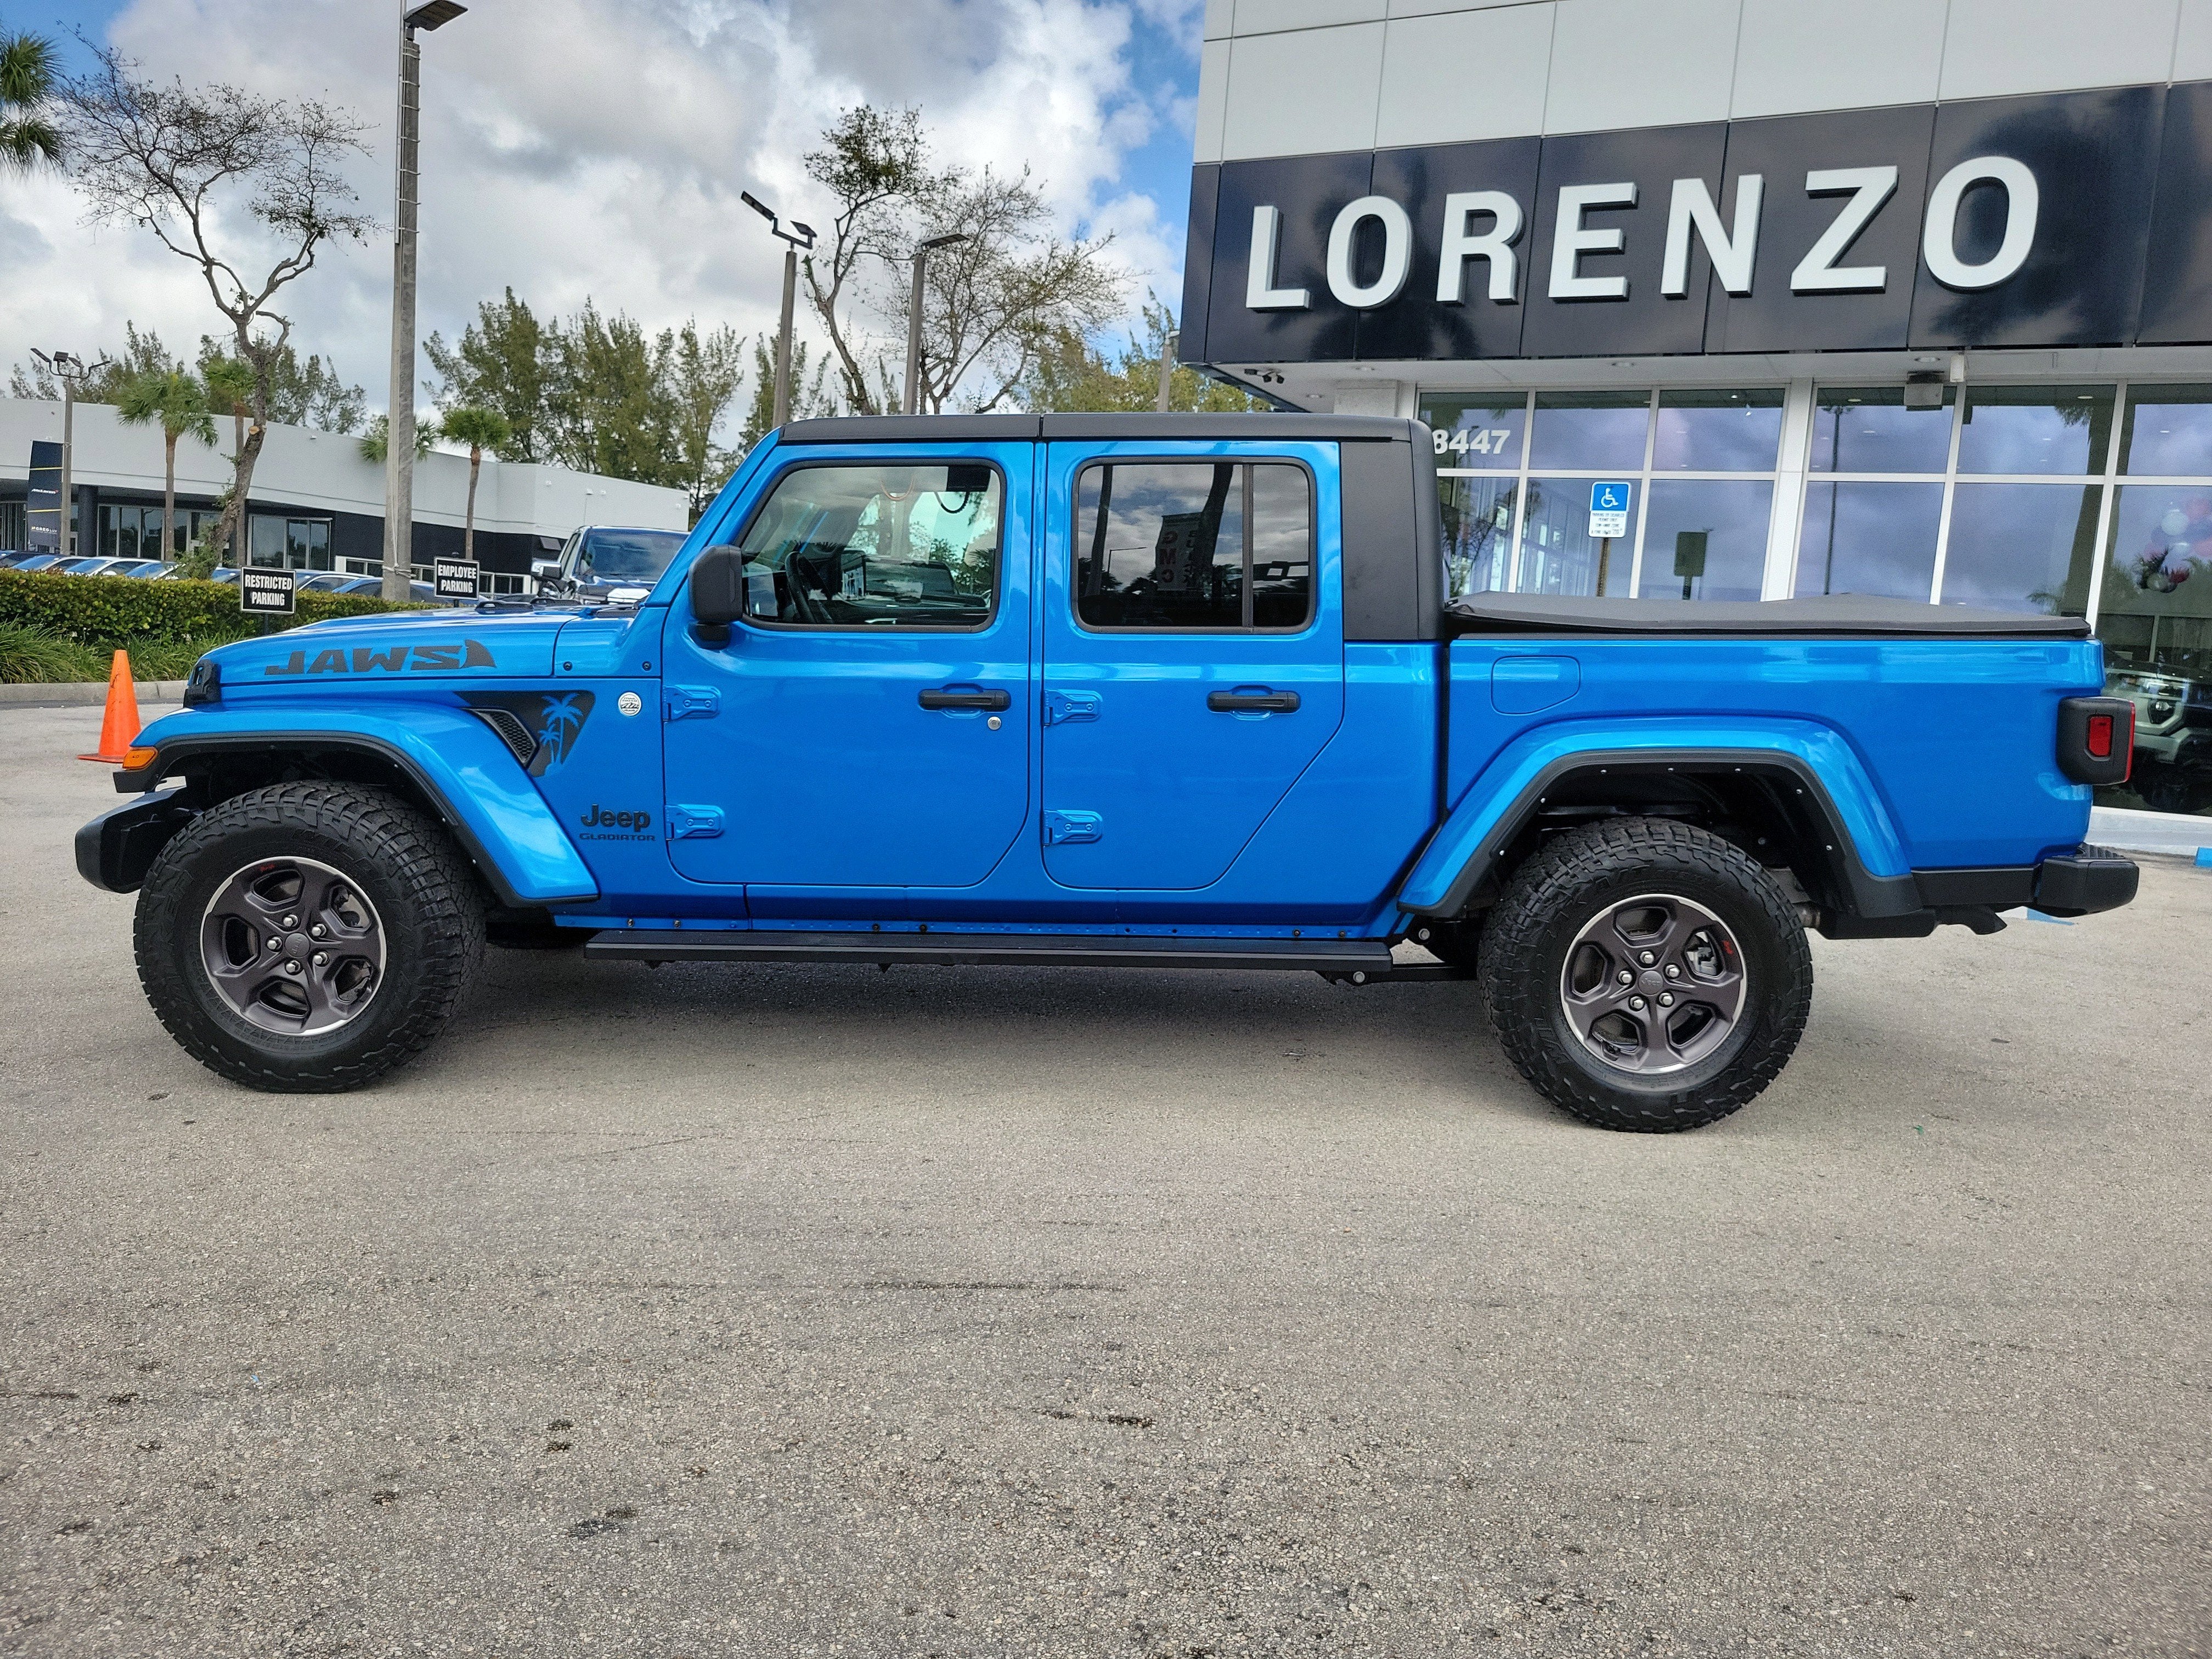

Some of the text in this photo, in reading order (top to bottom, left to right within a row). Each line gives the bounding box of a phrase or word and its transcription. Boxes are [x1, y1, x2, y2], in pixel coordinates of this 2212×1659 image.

[1245, 156, 2039, 311] LORENZO
[1432, 429, 1511, 454] 8447
[438, 564, 476, 579] EMPLOYEE
[245, 574, 292, 590] RESTRICTED
[441, 579, 473, 593] PARKING
[251, 591, 285, 606] PARKING
[264, 645, 462, 675] JAWS
[581, 804, 651, 832] Jeep
[579, 833, 656, 841] GLADIATOR
